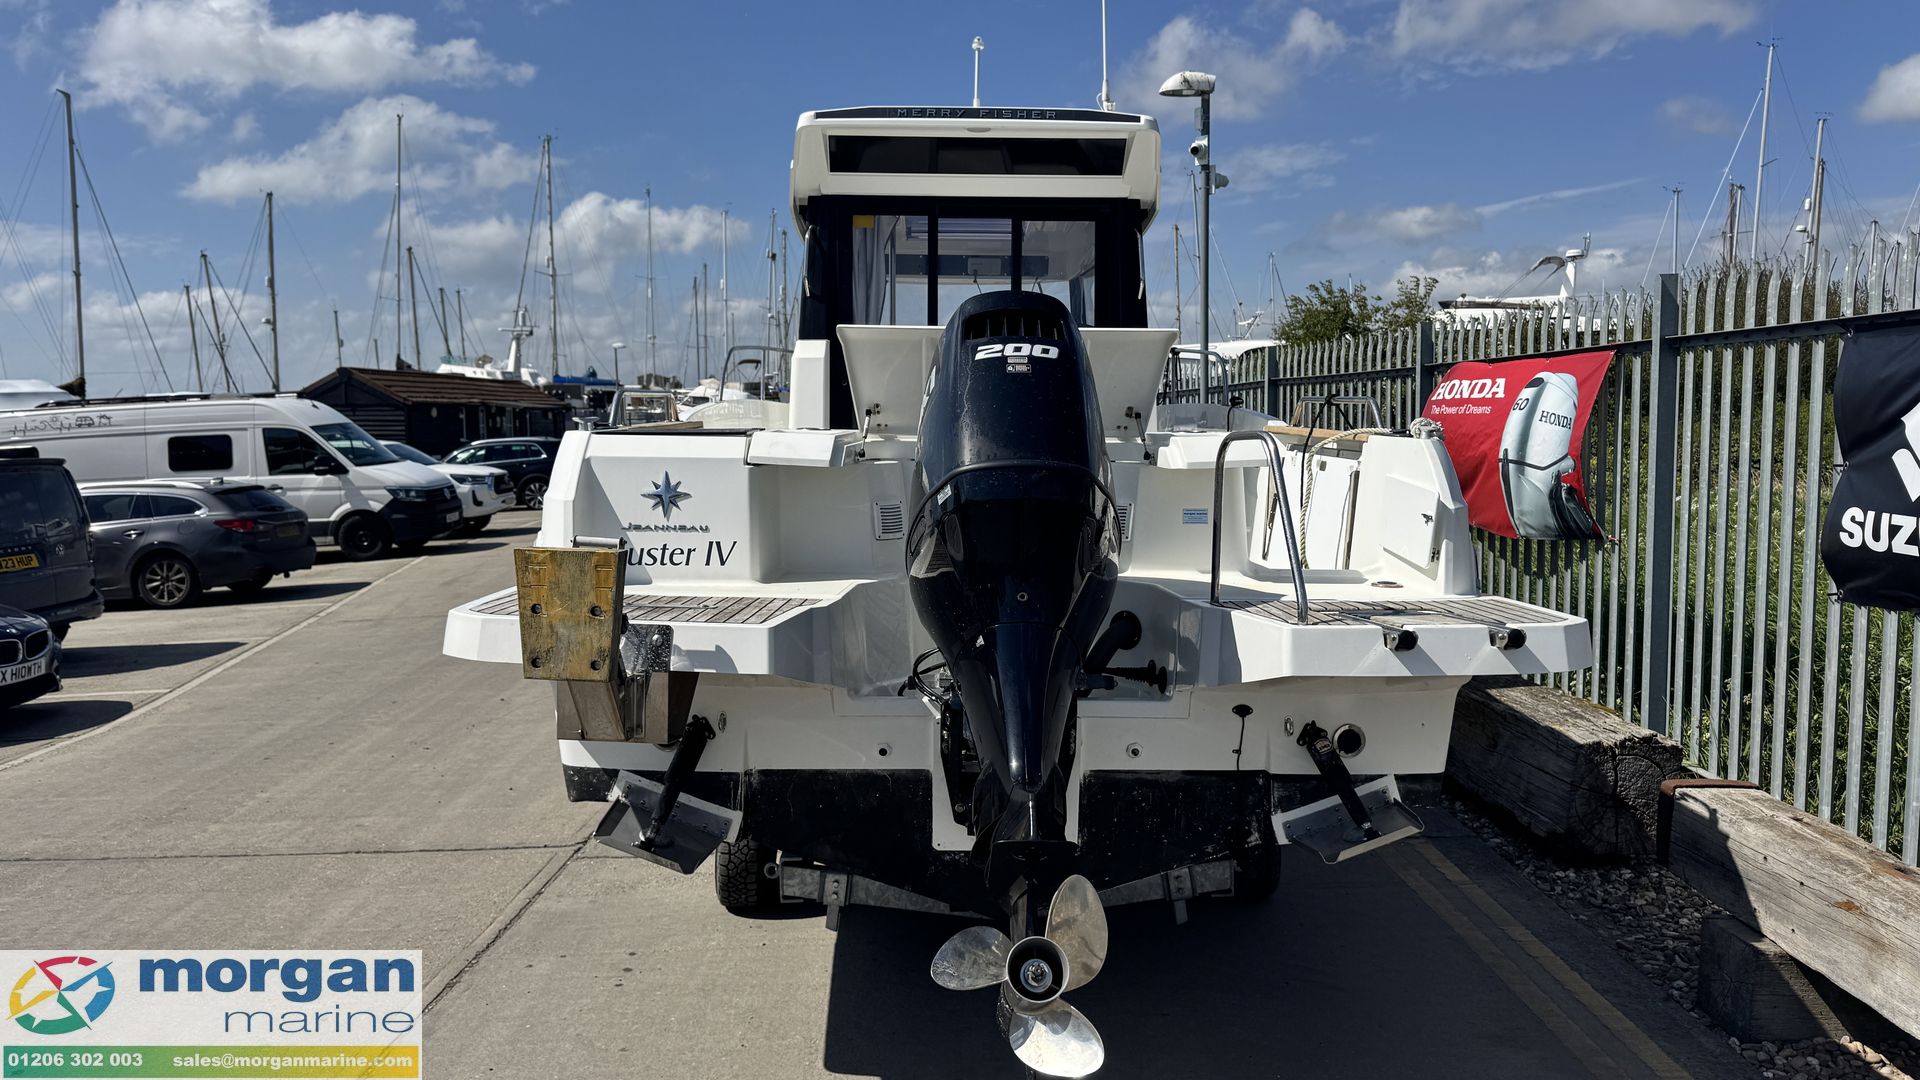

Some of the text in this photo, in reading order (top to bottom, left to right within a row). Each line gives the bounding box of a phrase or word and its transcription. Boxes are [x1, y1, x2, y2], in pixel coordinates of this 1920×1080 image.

[897, 108, 1057, 119] MERRY FISHER
[974, 343, 1059, 361] 200
[1431, 378, 1506, 401] HONDA
[1431, 404, 1492, 415] The Power of Dreams
[1512, 398, 1530, 412] 60
[1538, 410, 1573, 430] HONDA
[621, 522, 710, 533] JEANNEAU
[1839, 506, 1920, 557] SUZ
[627, 541, 738, 567] uster IV
